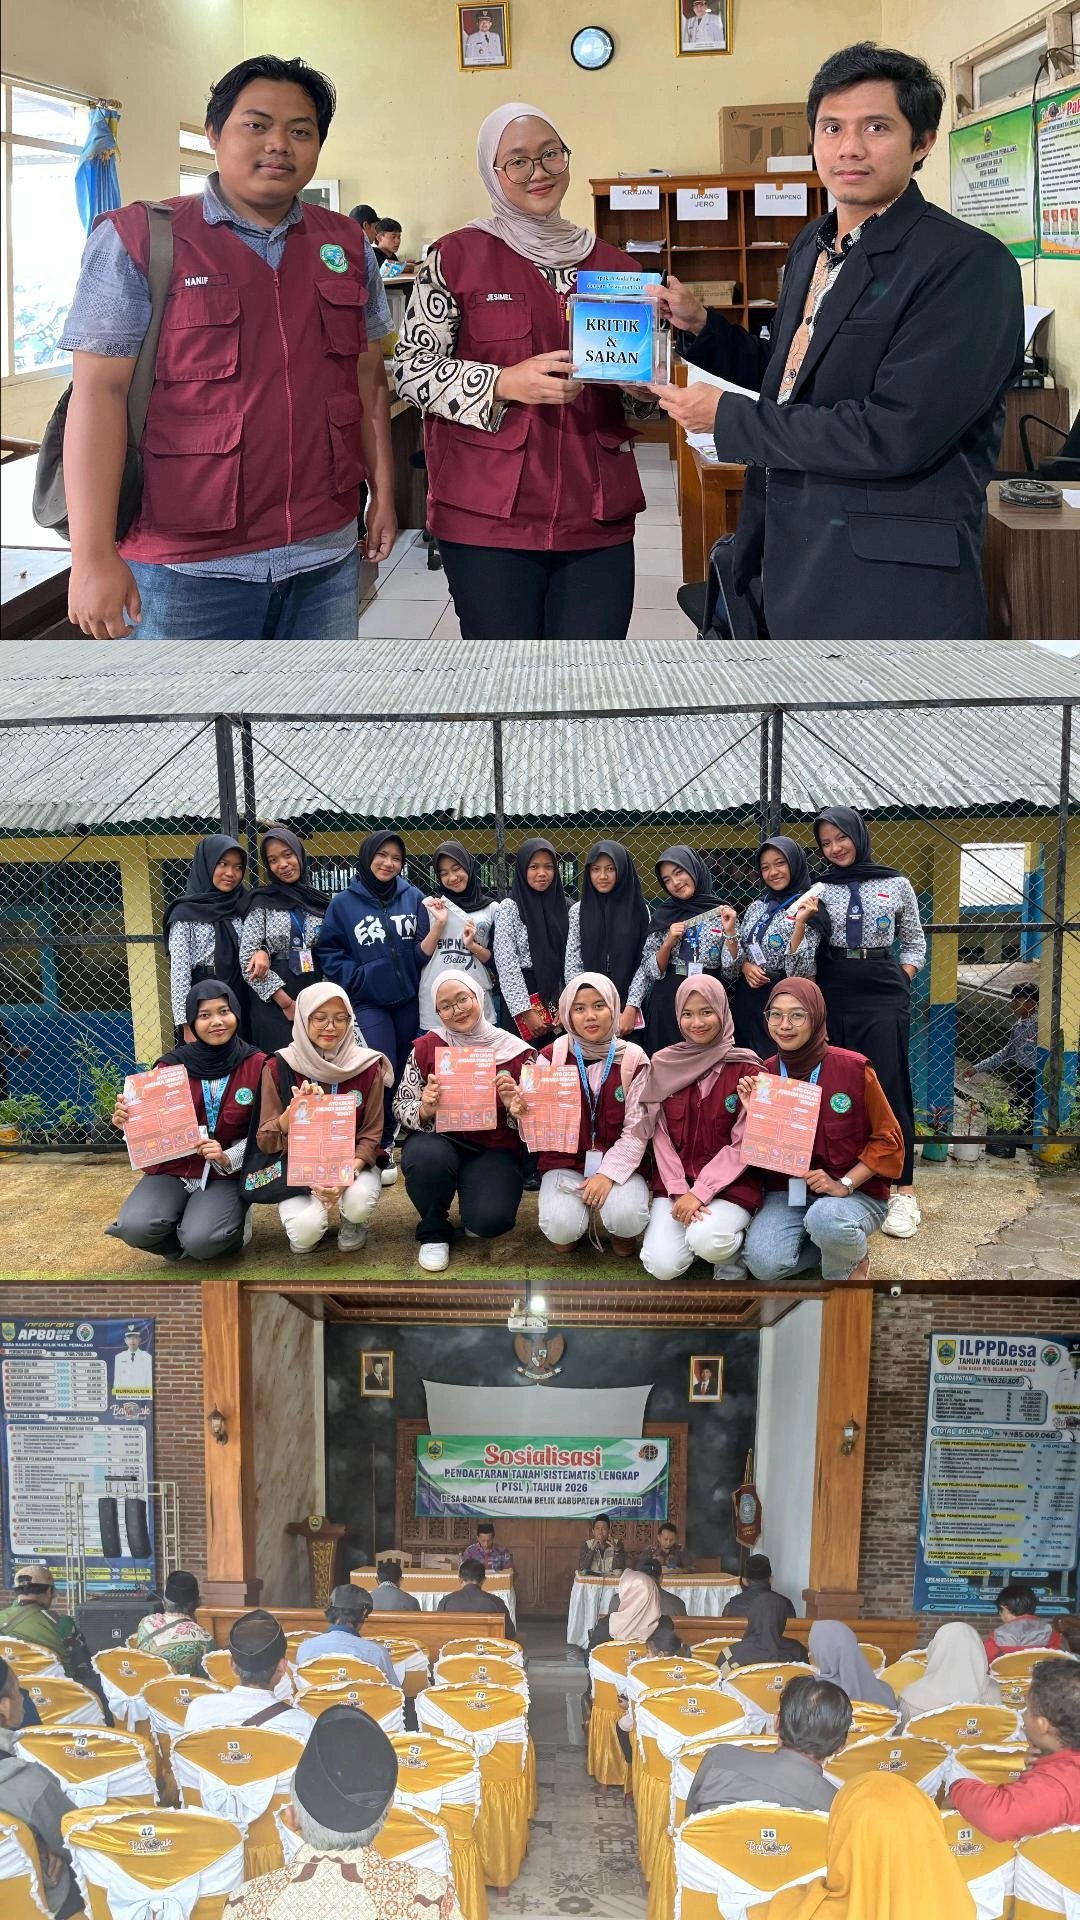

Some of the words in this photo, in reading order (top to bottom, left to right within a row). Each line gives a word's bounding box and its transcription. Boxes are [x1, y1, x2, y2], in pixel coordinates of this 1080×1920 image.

[184, 276, 208, 286] HANIF
[586, 319, 639, 332] KRITIK
[606, 336, 617, 347] &
[586, 350, 638, 364] SARAN
[437, 938, 461, 949] SMPN
[960, 1340, 1036, 1358] ILPPDesa
[484, 1444, 602, 1467] Sosialisasi
[444, 1469, 508, 1478] PENDAFTARAN
[512, 1470, 540, 1479] TANAH
[544, 1470, 596, 1480] SISTEMATIS
[599, 1471, 639, 1480] LENGKAP
[502, 1482, 524, 1492] PTSL
[533, 1483, 562, 1492] TAHUN
[565, 1483, 588, 1492] 2026
[489, 1496, 532, 1504] KECAMATAN
[142, 1827, 153, 1836] 42
